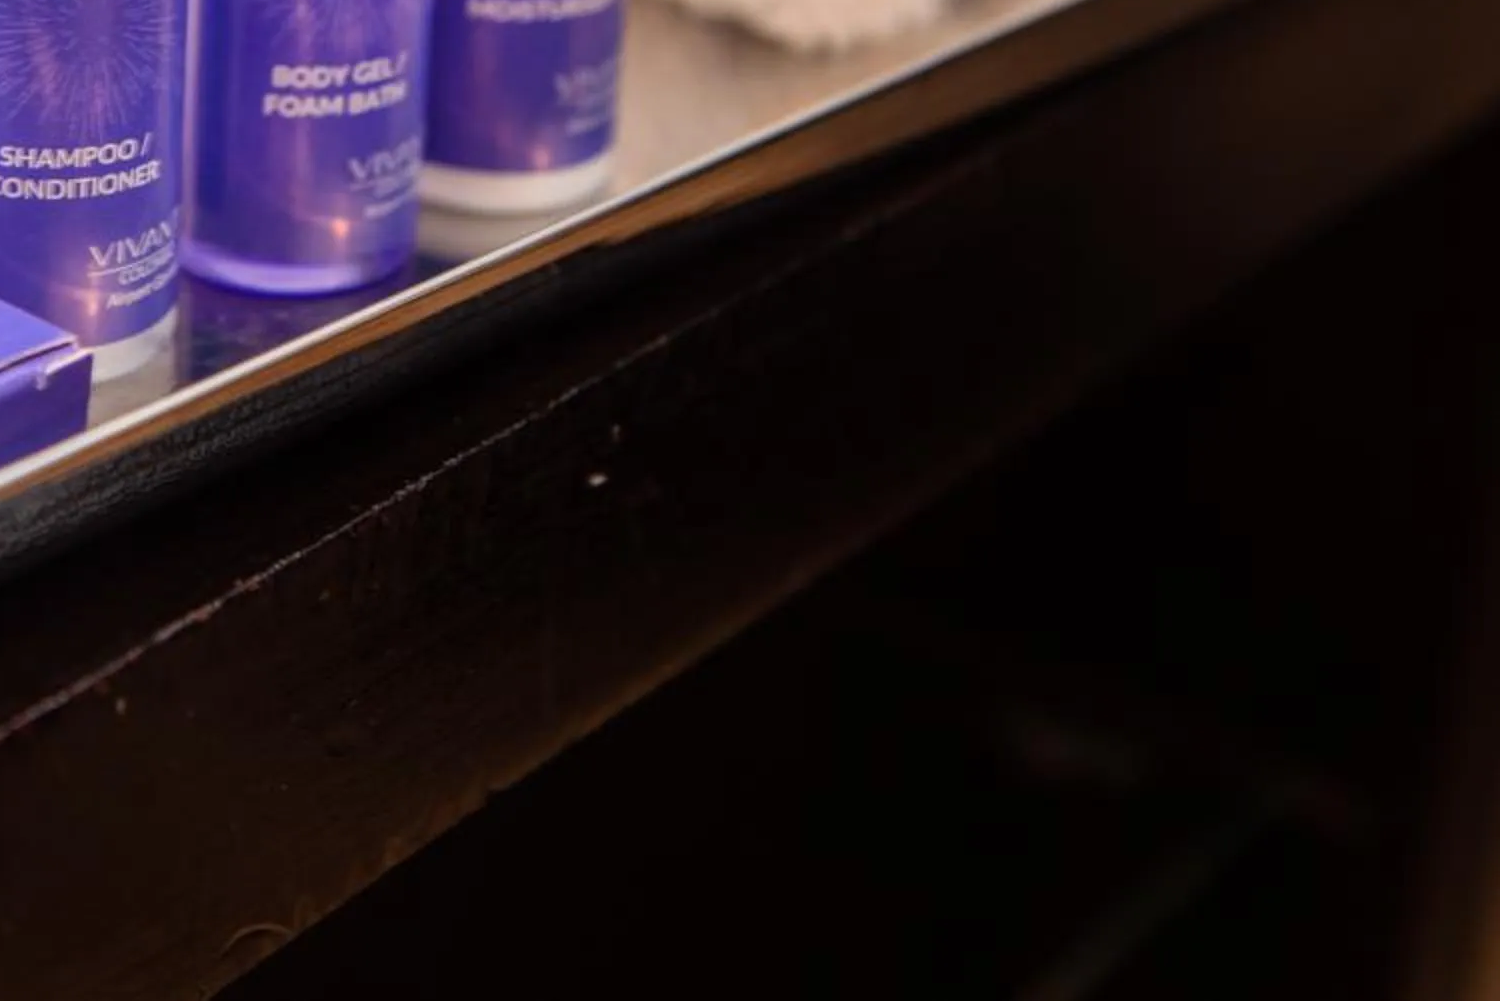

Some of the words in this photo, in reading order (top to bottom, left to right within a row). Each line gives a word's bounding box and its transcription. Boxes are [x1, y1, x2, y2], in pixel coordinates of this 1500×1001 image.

[270, 64, 350, 89] BODY
[352, 57, 392, 84] GEL
[262, 93, 344, 118] FOAM
[348, 79, 407, 115] BATH
